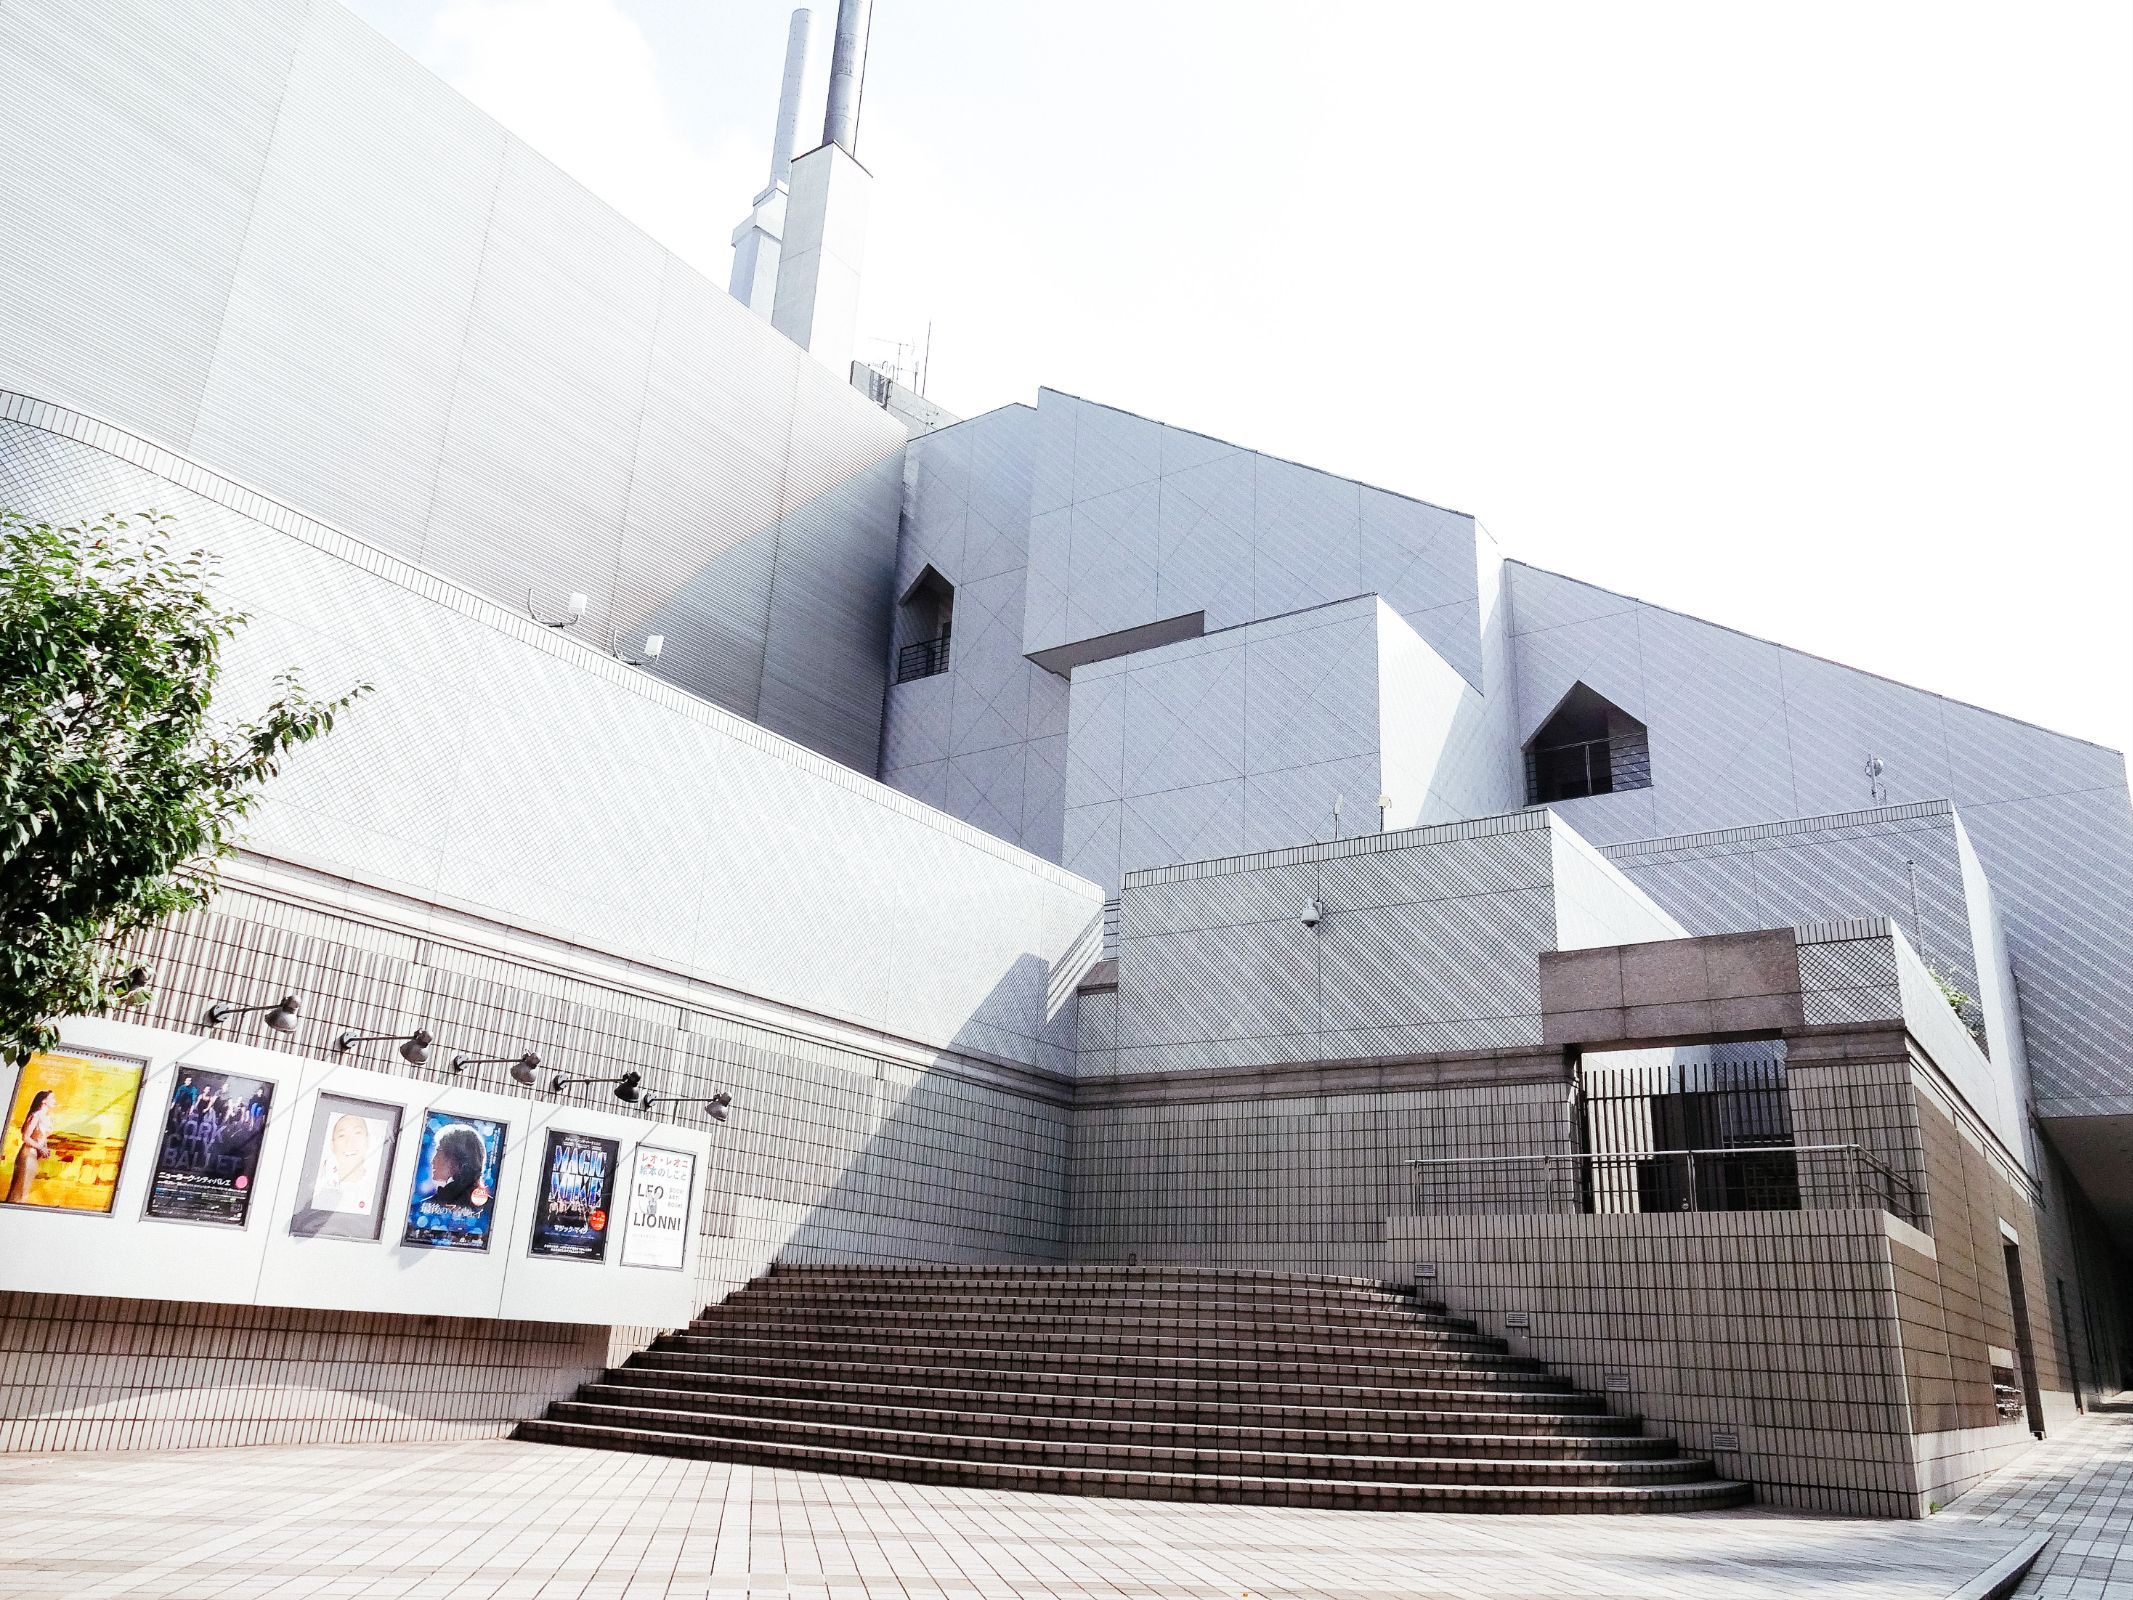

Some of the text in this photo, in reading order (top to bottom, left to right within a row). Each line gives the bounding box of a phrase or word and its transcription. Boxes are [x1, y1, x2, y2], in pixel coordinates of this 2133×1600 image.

[553, 1145, 607, 1178] MAGIC
[641, 1153, 689, 1169] レオ・レオニ
[548, 1171, 604, 1207] MIKE
[637, 1183, 664, 1200] LEO
[633, 1212, 681, 1231] LIONNI
